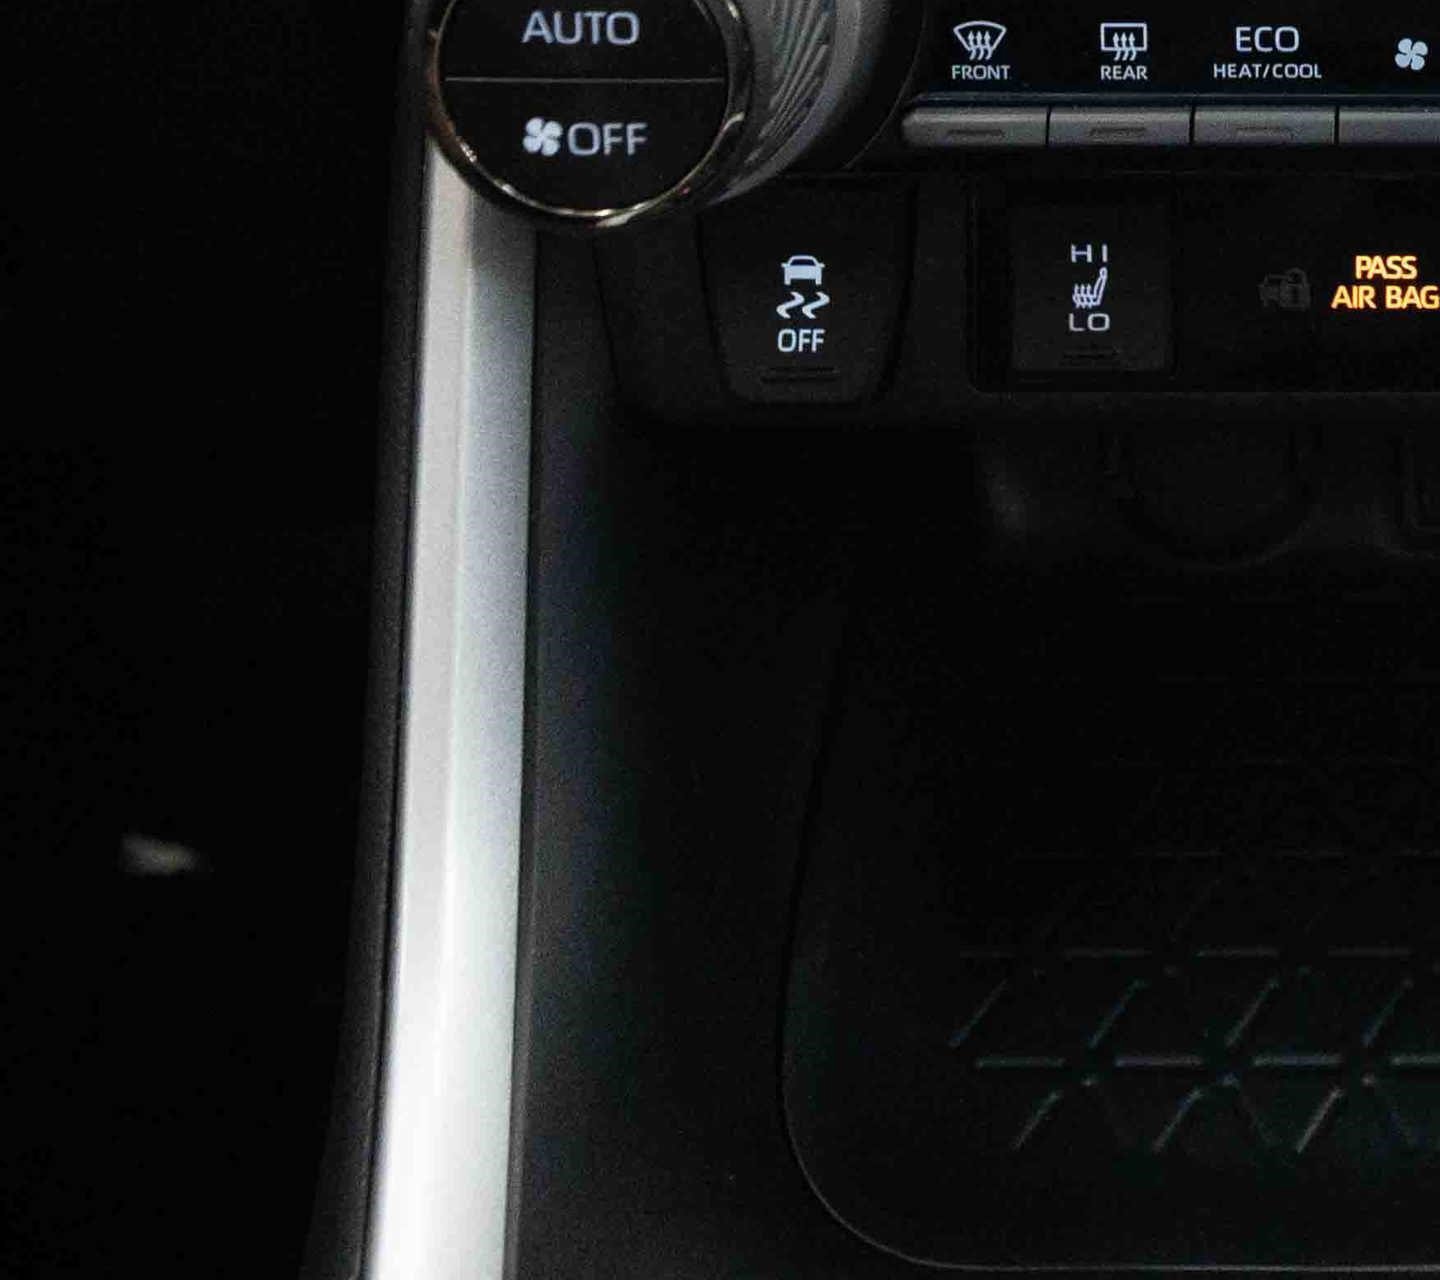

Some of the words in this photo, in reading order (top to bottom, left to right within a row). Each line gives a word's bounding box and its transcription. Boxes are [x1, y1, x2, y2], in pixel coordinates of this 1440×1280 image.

[522, 10, 640, 46] AUTO
[1235, 26, 1300, 53] ECO
[951, 64, 1011, 81] FRONT
[1100, 64, 1148, 81] REAR
[1213, 63, 1322, 80] HEAT/COOL
[567, 122, 648, 156] OFF
[1070, 244, 1108, 263] HI
[1355, 255, 1418, 280] PASS
[1330, 285, 1377, 310] AIR
[1384, 285, 1440, 310] BAG
[1068, 312, 1111, 332] LO
[777, 328, 826, 353] OFF
